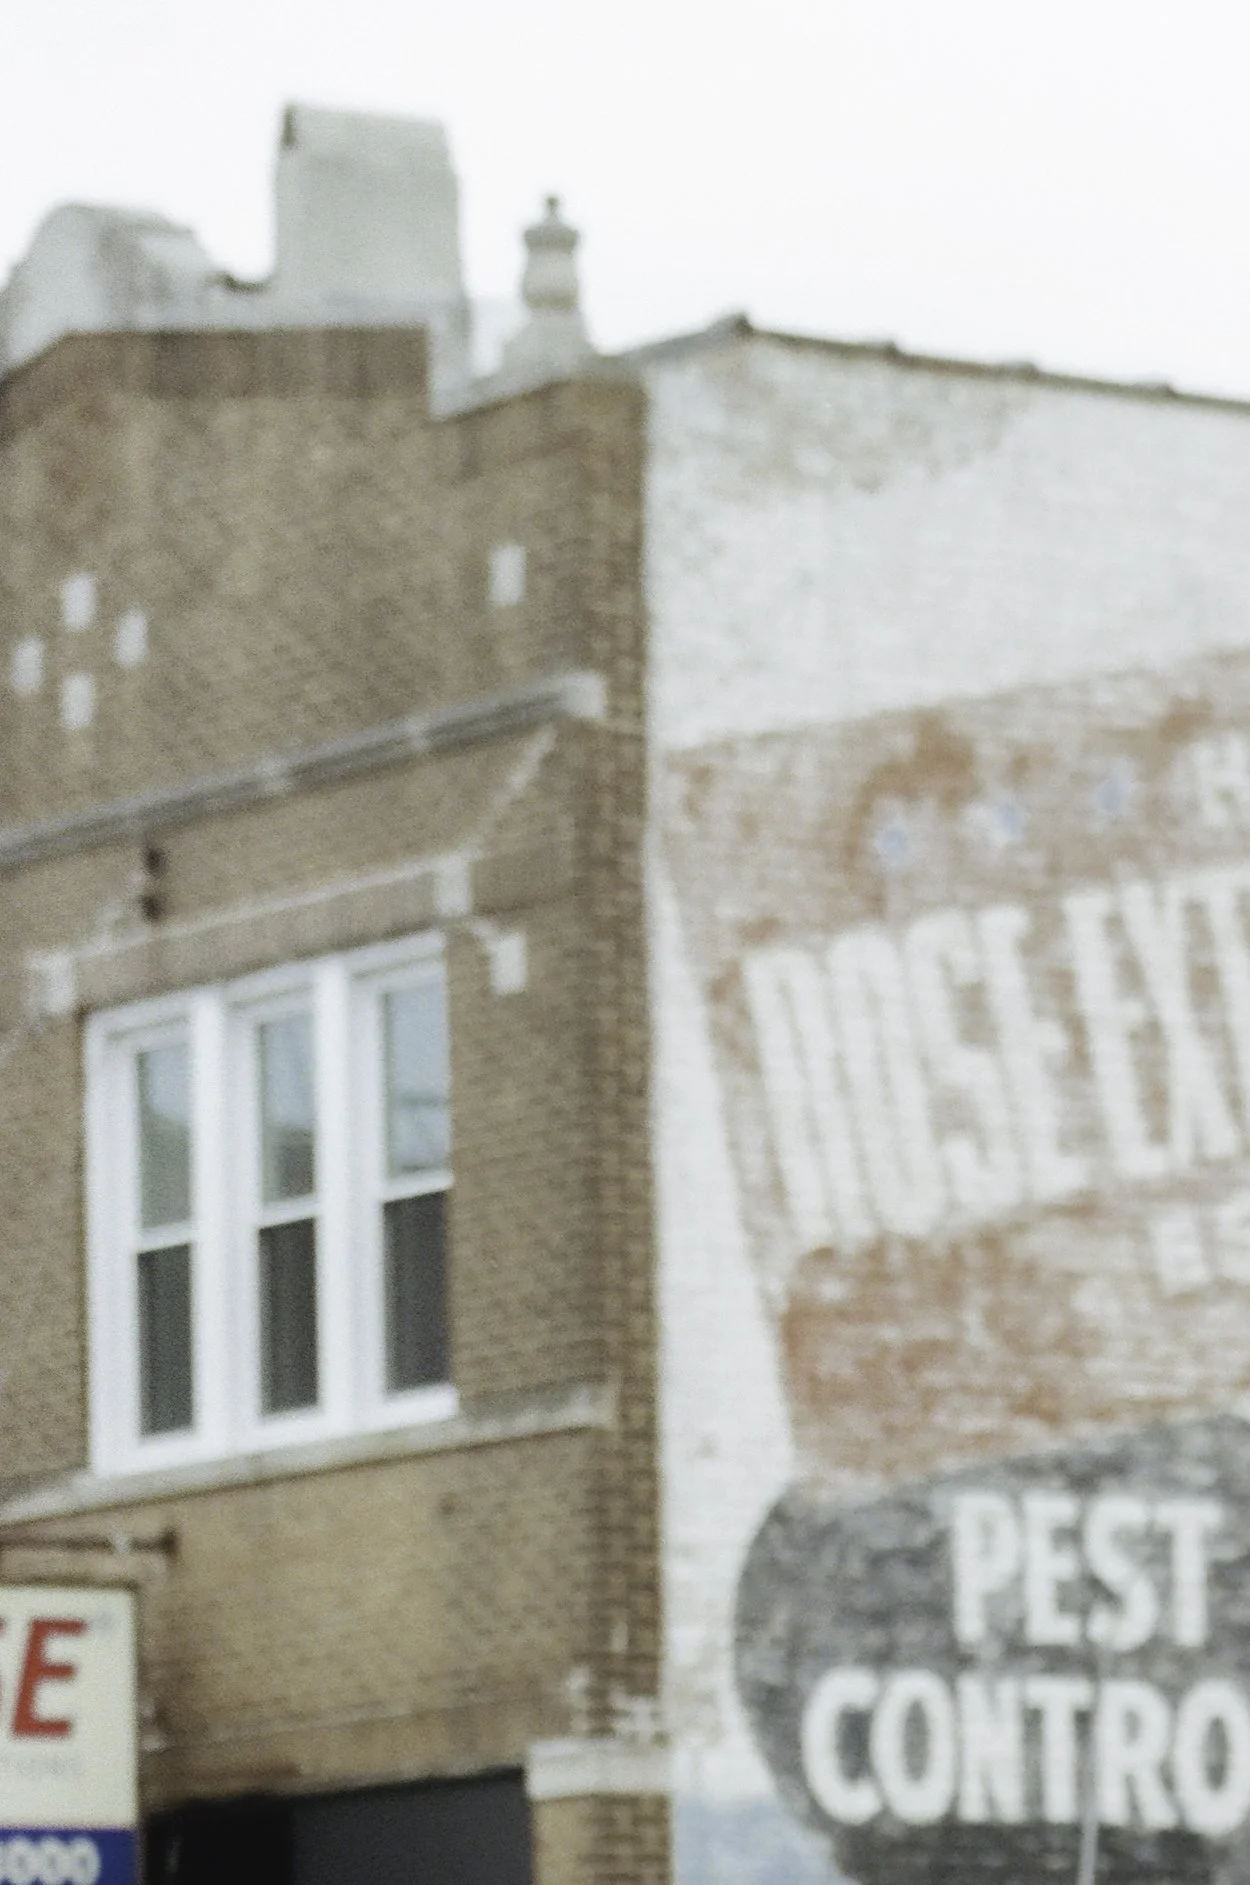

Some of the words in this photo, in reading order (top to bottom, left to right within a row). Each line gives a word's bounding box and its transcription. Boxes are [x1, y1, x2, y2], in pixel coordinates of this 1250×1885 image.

[742, 903, 1092, 1246] ROSE
[950, 1492, 1222, 1654] PEST
[0, 1617, 87, 1738] E
